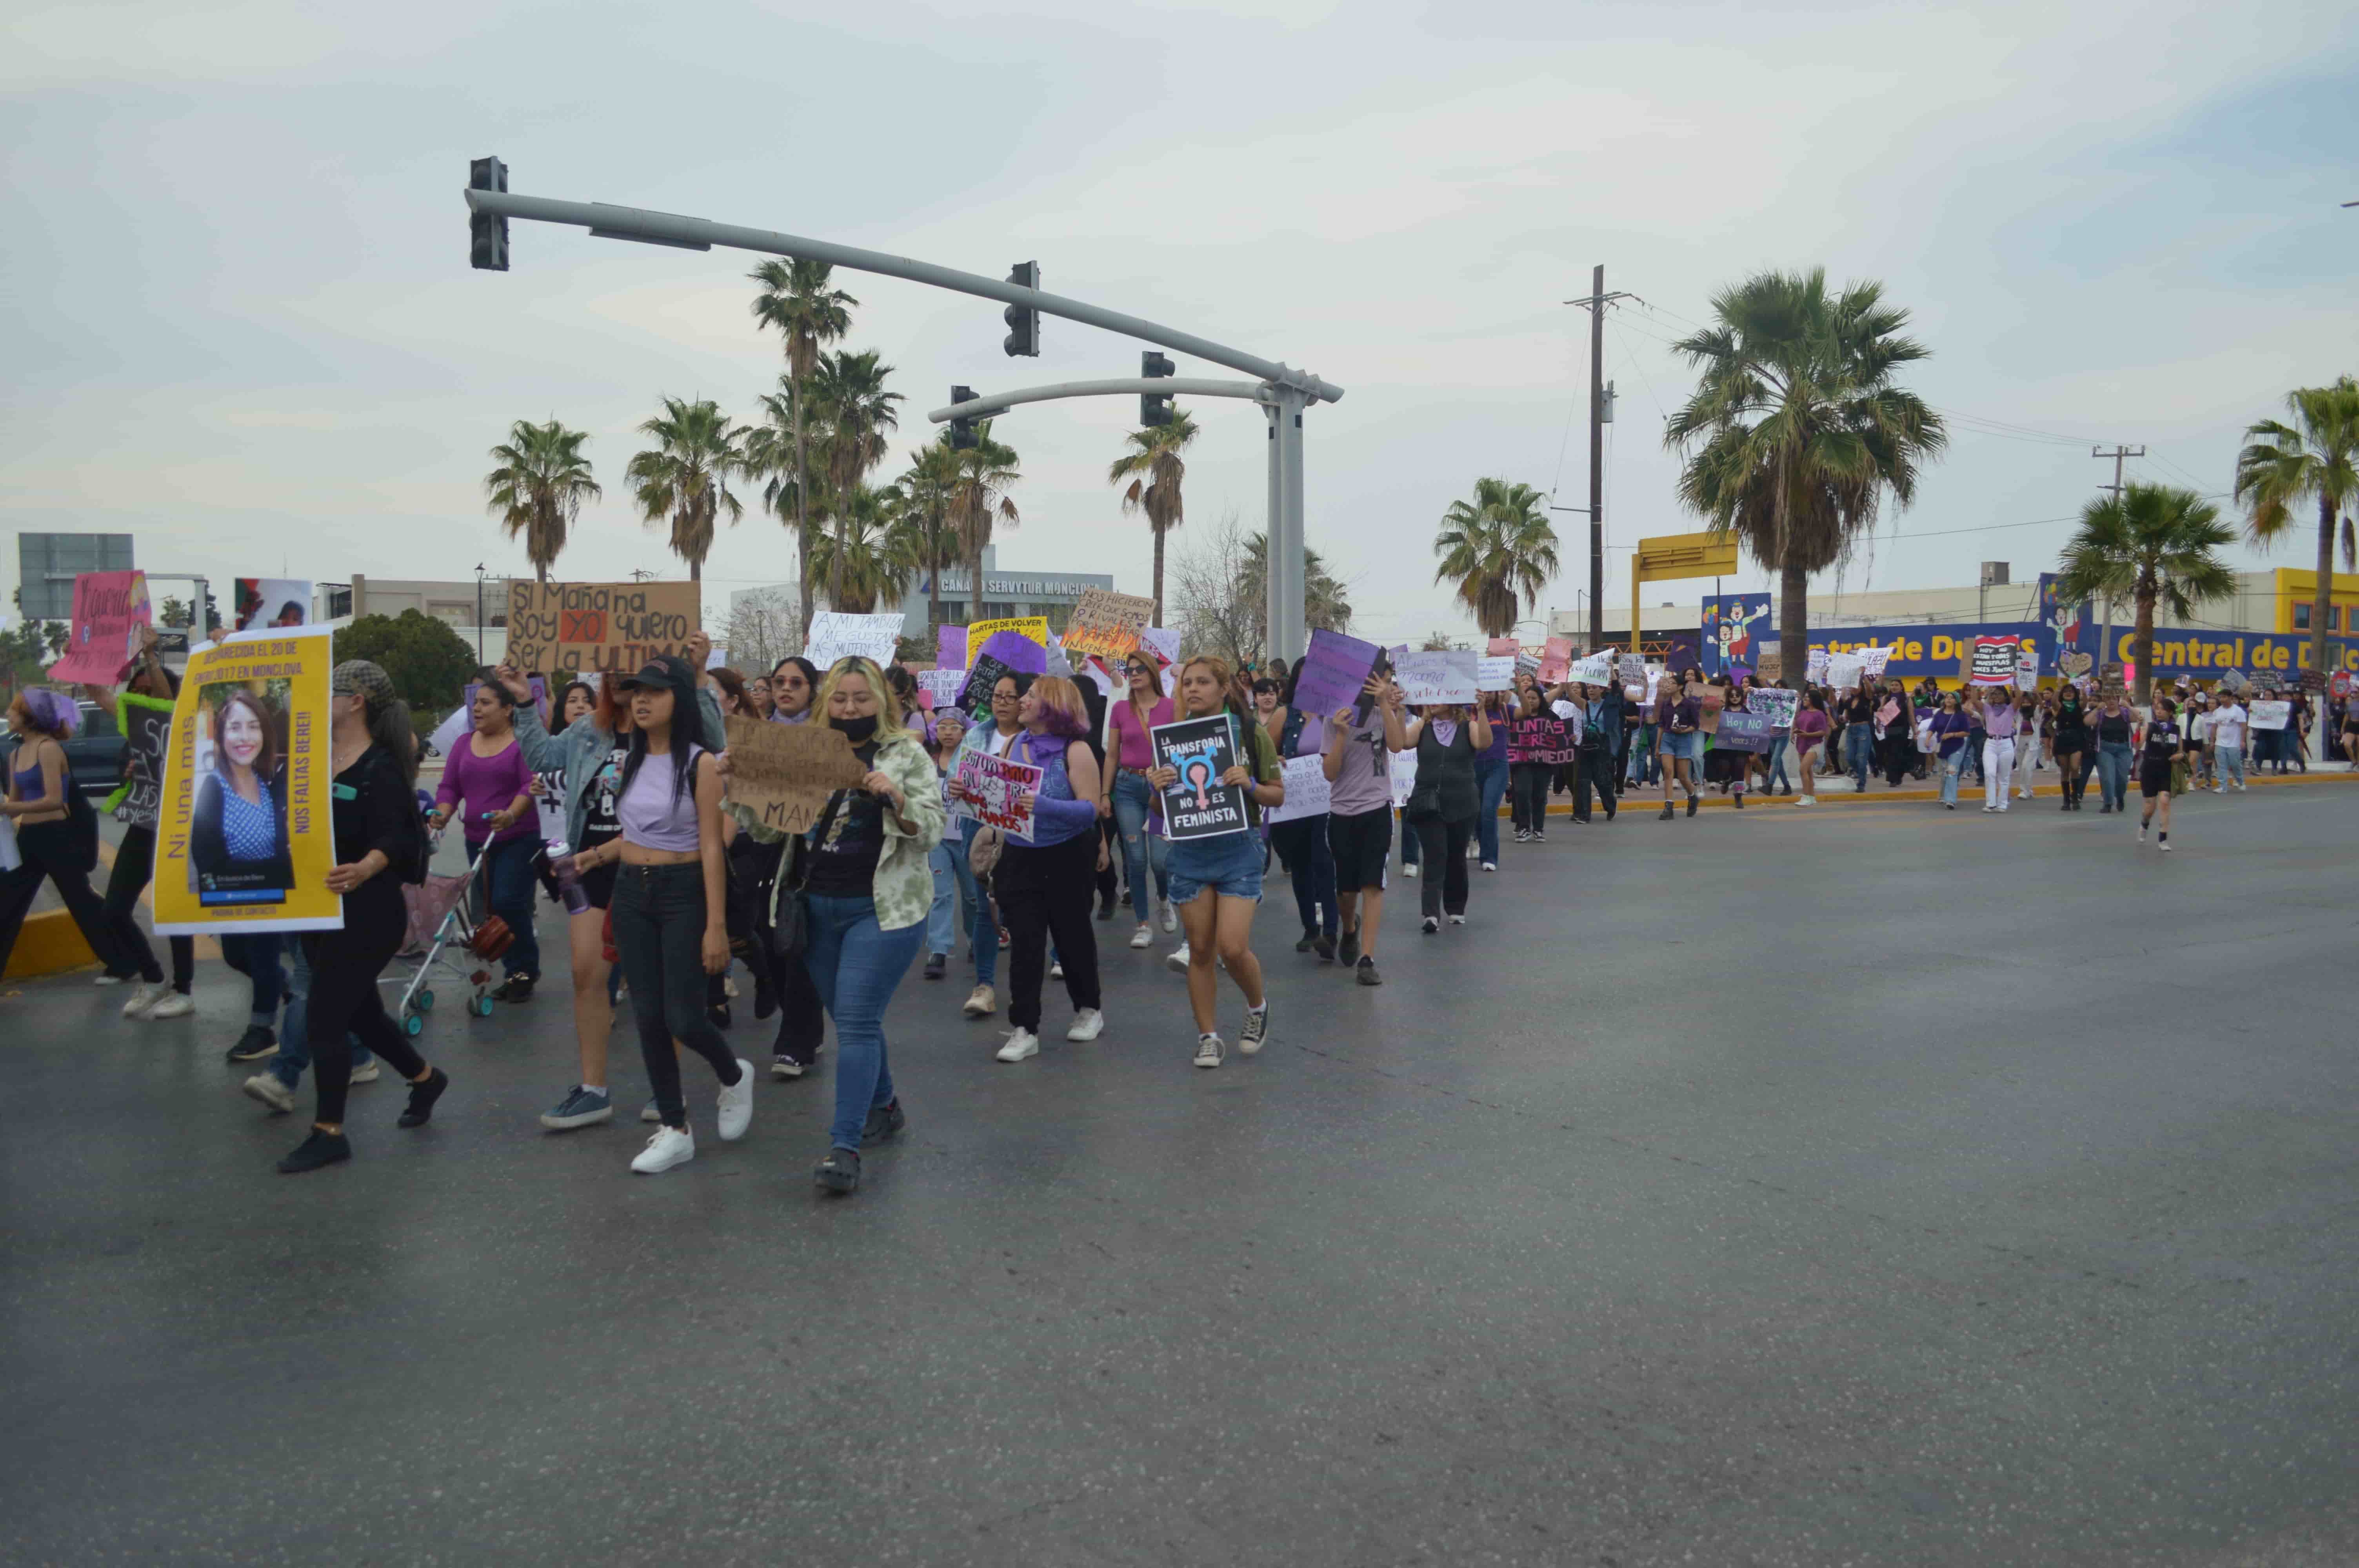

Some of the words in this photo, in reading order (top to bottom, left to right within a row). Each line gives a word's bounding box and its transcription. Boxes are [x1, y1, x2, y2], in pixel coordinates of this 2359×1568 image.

[941, 579, 986, 593] CANAO
[988, 579, 1041, 595] SERVYTUR
[816, 613, 831, 628] A
[834, 614, 854, 628] MI
[1089, 610, 1132, 627] RIVALES
[969, 622, 998, 636] HARTAS
[846, 631, 897, 644] GUSTAN
[257, 643, 267, 656] EL
[271, 642, 283, 656] 20
[285, 641, 297, 655] DE
[1887, 637, 1923, 661] de
[2118, 633, 2245, 667] Central
[2252, 639, 2290, 668] de
[238, 665, 249, 679] EN
[1508, 718, 1565, 734] JUNTAS
[1747, 719, 1763, 729] NO
[1161, 736, 1171, 746] LA
[1507, 732, 1556, 748] LIBRES
[1507, 748, 1528, 763] SIN
[1535, 748, 1574, 764] MIEDO
[294, 756, 309, 804] FALTAS
[1179, 797, 1193, 810] NO
[1212, 791, 1226, 804] ES
[167, 833, 185, 859] Ni
[176, 778, 192, 826] una
[295, 806, 310, 834] NOS
[1174, 806, 1238, 828] FEMINISTA
